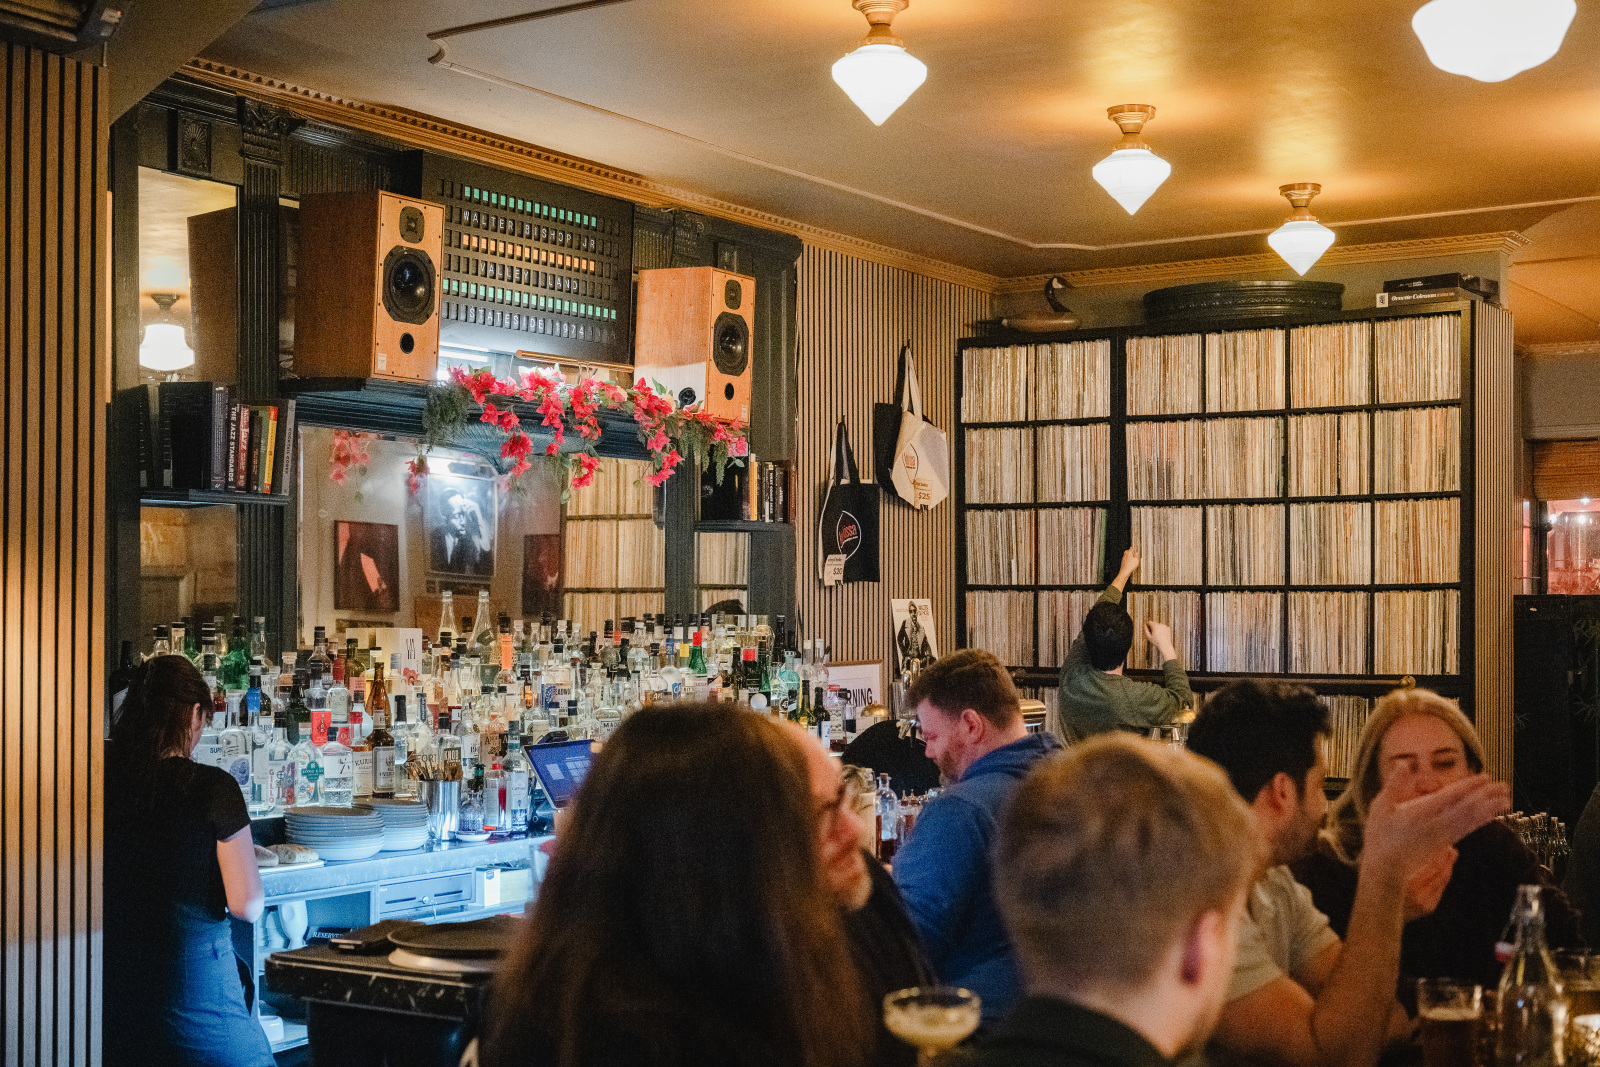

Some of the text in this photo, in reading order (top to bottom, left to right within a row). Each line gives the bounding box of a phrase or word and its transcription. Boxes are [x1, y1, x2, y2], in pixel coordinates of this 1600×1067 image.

[463, 210, 595, 249] WALTER BISHOP JR
[480, 262, 578, 290] VALLEY LAND
[469, 308, 584, 336] STATESIDE 1974
[918, 491, 931, 500] $25
[833, 567, 843, 576] $20
